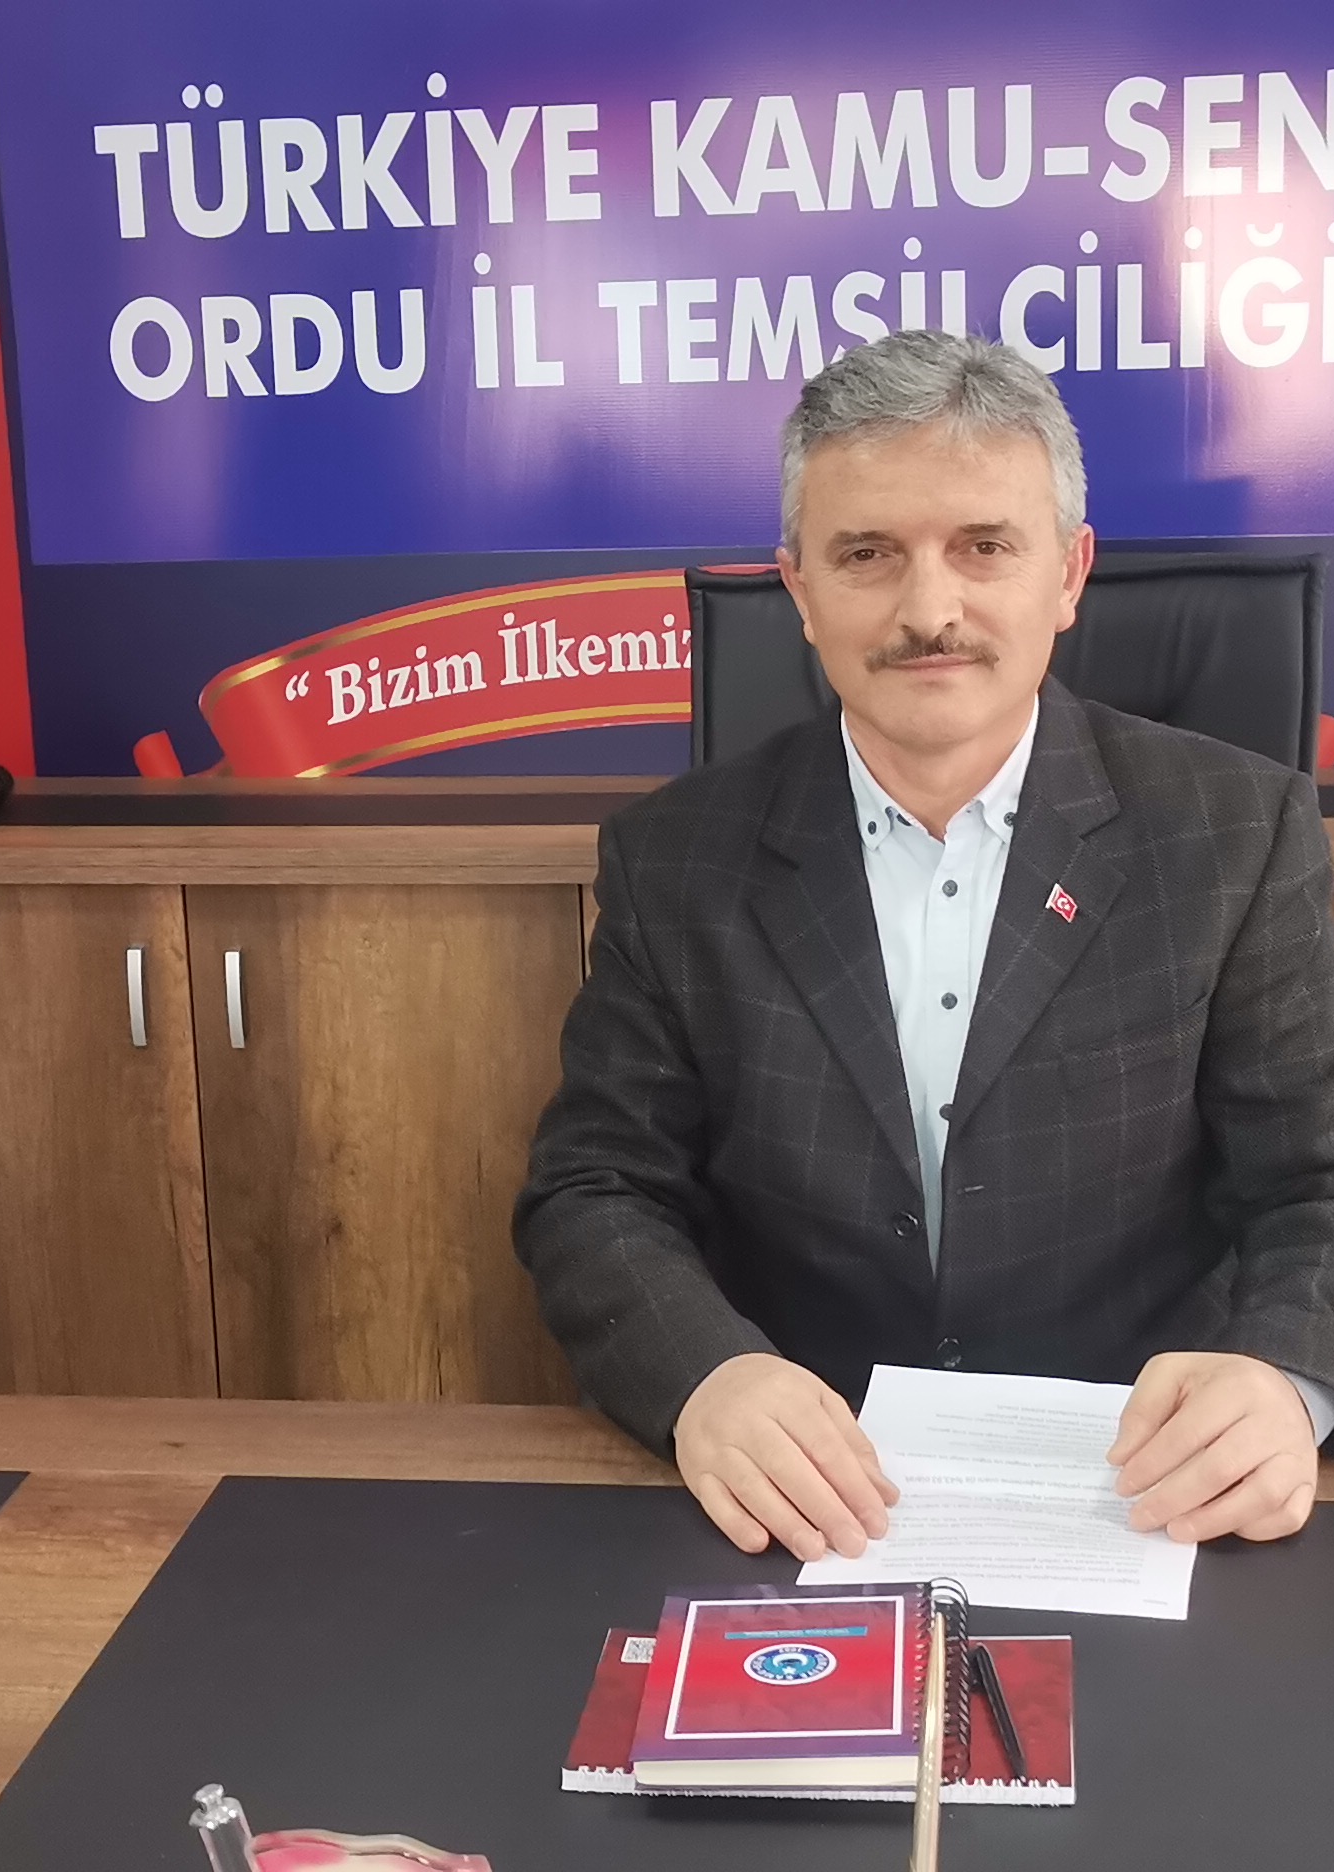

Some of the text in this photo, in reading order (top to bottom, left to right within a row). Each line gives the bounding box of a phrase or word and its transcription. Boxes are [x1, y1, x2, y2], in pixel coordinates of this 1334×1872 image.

[94, 72, 602, 239] TÜRKİYE
[110, 288, 426, 402] ORDU
[473, 252, 564, 389] İL
[325, 645, 486, 726] Bizim
